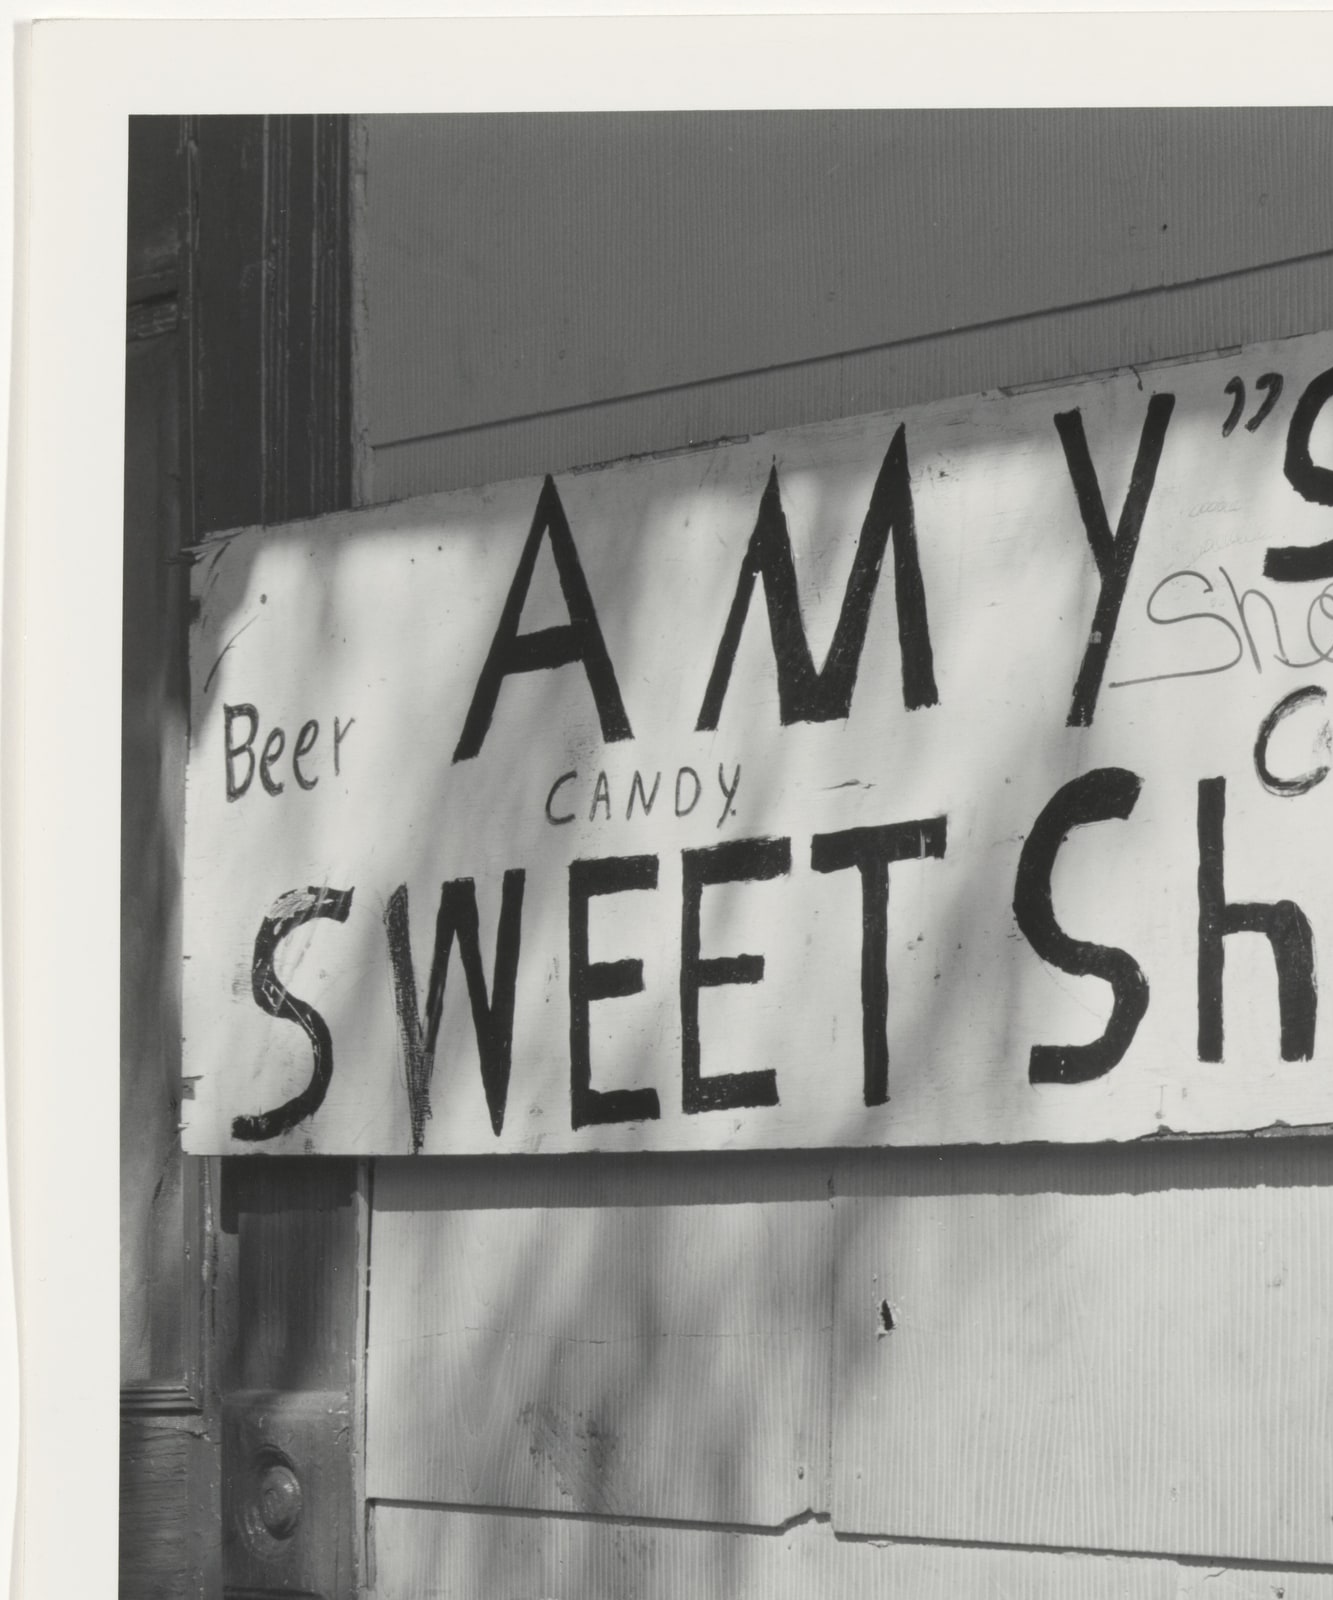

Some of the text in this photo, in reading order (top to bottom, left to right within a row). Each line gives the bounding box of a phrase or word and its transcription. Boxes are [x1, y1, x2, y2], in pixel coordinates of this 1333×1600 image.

[223, 703, 356, 803] Beer
[545, 762, 743, 829] CANDY
[231, 816, 948, 1155] SWEET
